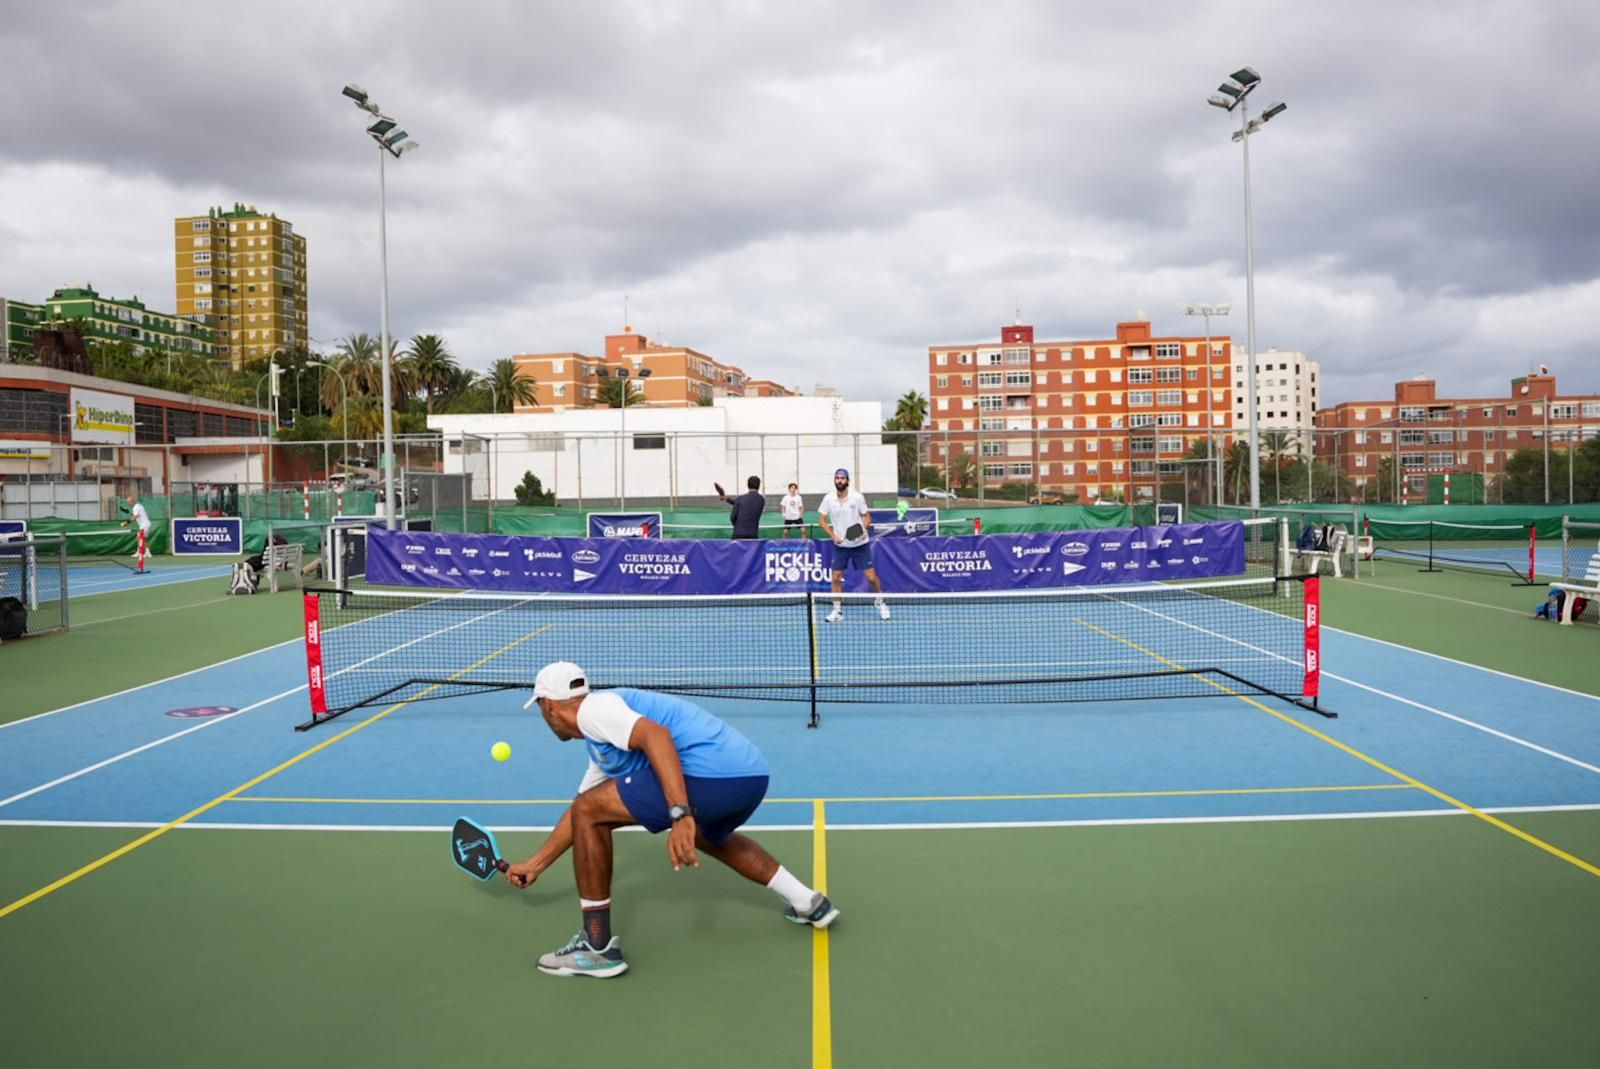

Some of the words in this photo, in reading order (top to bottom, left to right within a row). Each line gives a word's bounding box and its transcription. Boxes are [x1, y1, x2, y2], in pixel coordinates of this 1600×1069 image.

[88, 407, 133, 424] HiperDino
[182, 534, 232, 542] VICTORIA
[624, 554, 686, 563] CERVEZAS
[765, 553, 822, 567] PICKLE
[925, 550, 986, 560] CERVEZAS
[619, 563, 691, 574] VICTORIA
[920, 560, 992, 572] VICTORIA
